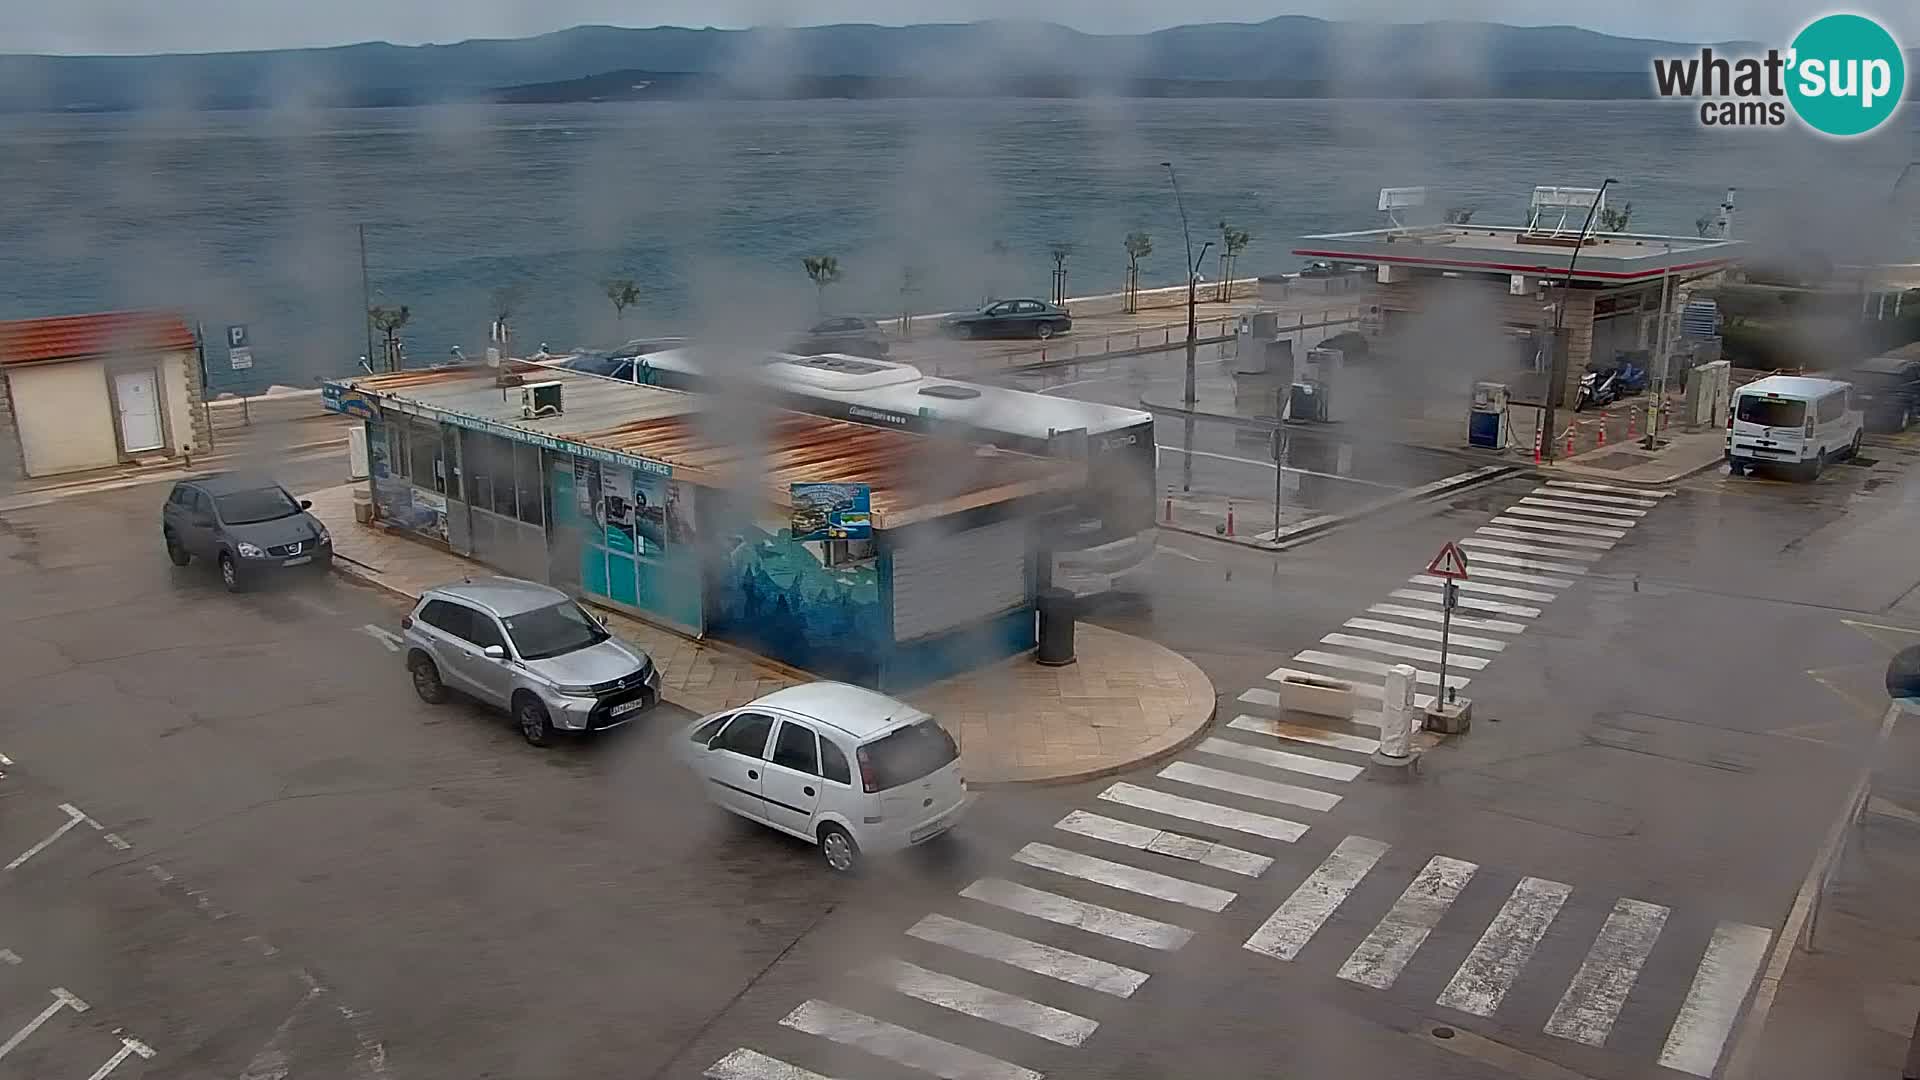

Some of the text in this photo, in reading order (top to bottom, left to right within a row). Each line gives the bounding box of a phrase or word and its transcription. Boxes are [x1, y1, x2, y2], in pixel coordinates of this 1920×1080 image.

[231, 327, 243, 345] P
[567, 443, 581, 455] BUS
[616, 455, 641, 470] TICKET
[643, 460, 669, 475] OFFICE
